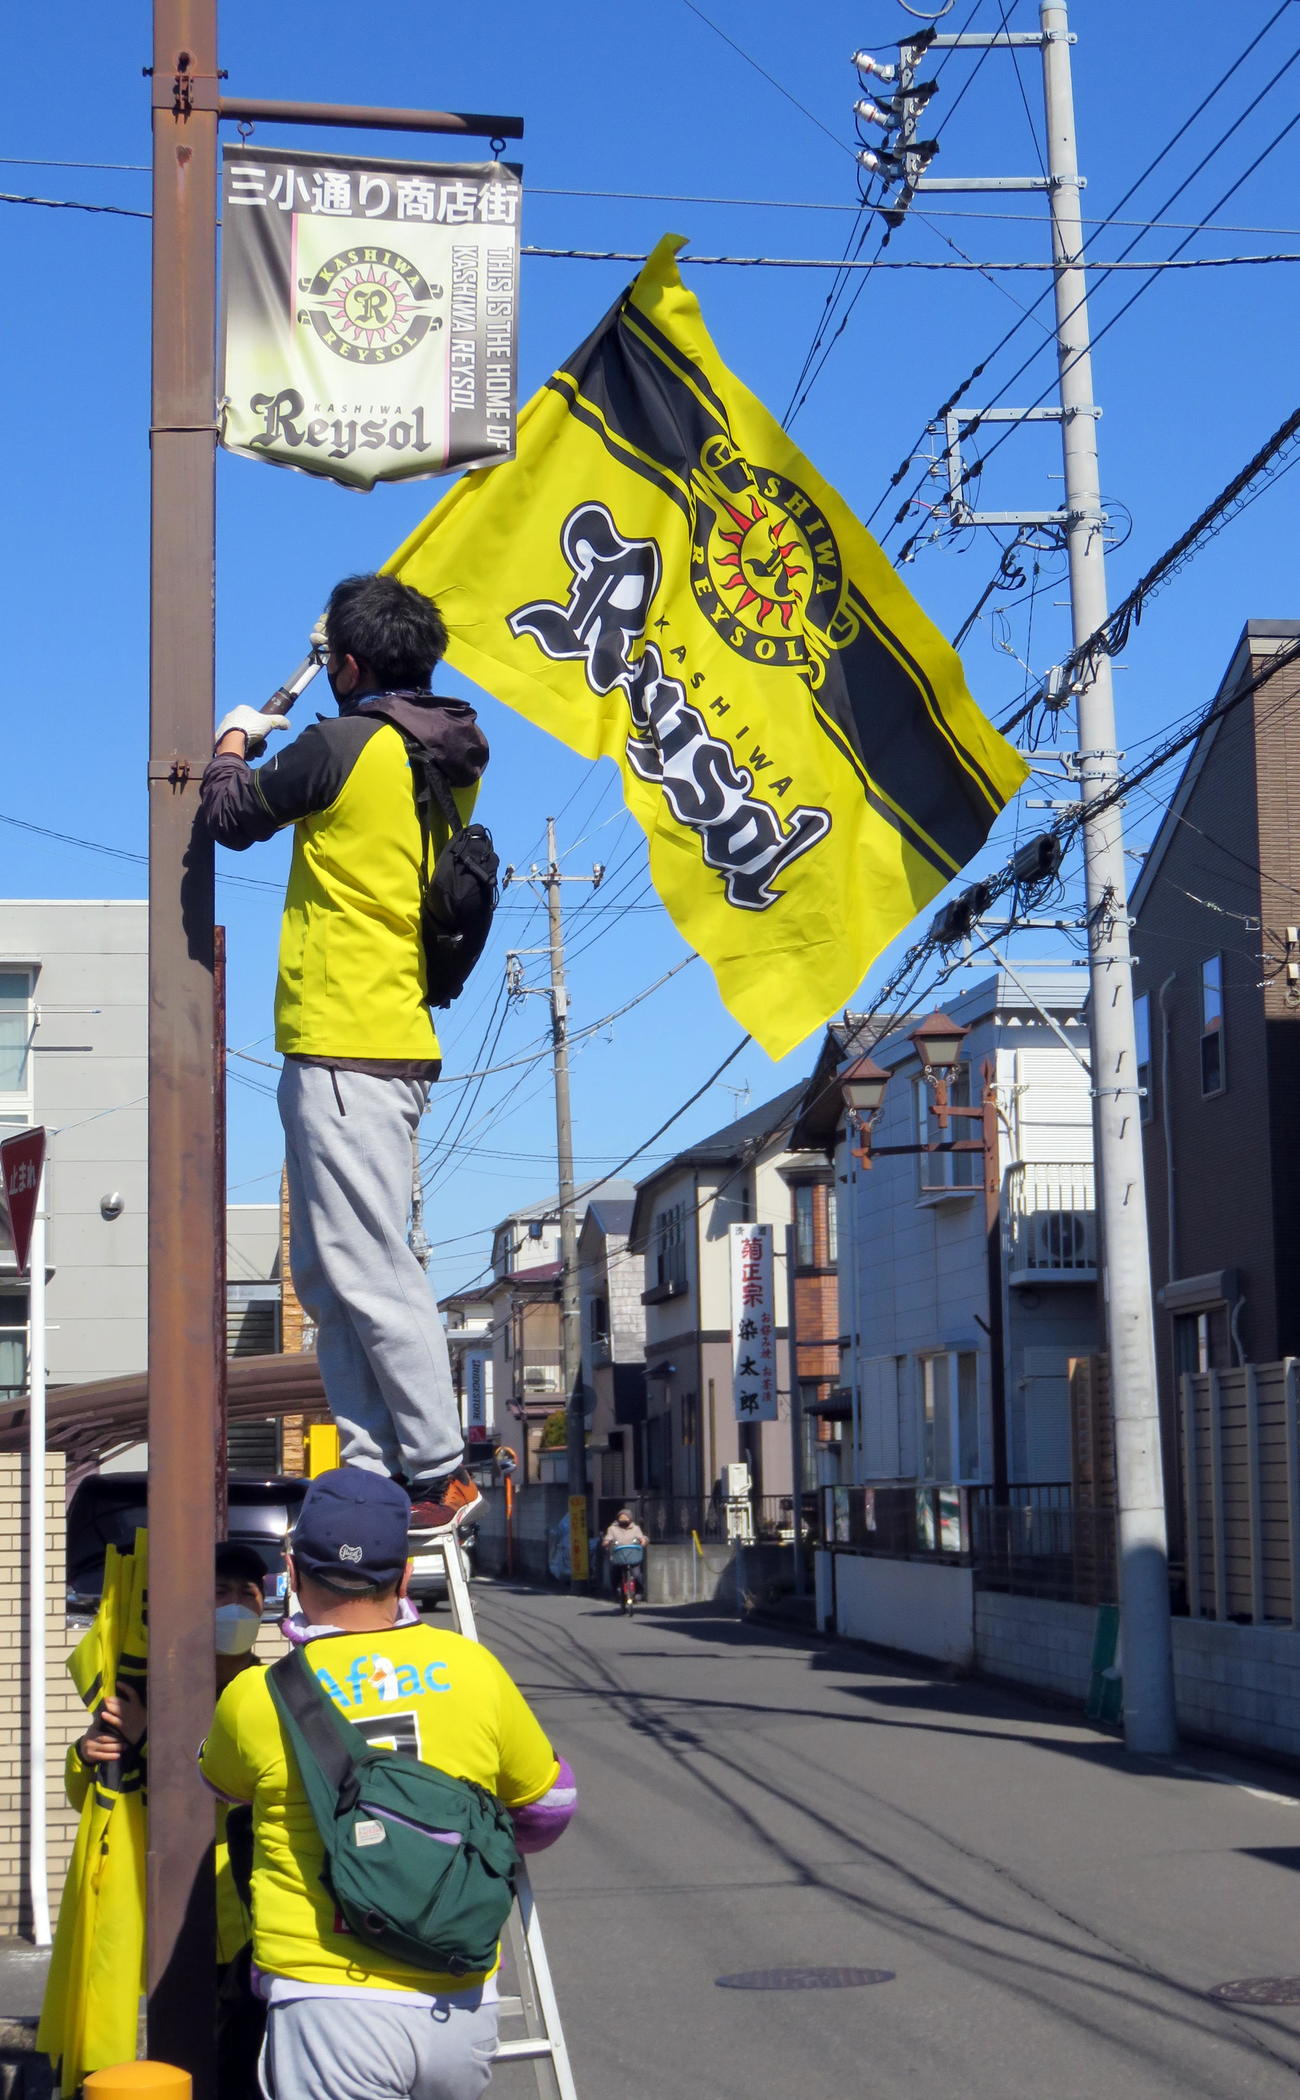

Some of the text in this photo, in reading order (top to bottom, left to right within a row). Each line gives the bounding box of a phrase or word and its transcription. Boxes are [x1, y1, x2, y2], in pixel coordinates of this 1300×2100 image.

[228, 166, 519, 224] 三小通り商店街
[319, 248, 421, 287] KASHIWA
[322, 333, 418, 362] REYSOL
[450, 245, 479, 413] KASHIWA REYSOL
[486, 247, 514, 451] THIS IS THE HOME OF
[250, 388, 432, 459] Reysol
[314, 403, 403, 415] KASHIWA
[693, 544, 804, 662] REYSOL
[654, 616, 794, 797] KASHIWA
[9, 1159, 36, 1195] 止まれ
[741, 1237, 763, 1307] 菊正宗
[738, 1319, 760, 1416] 染太郎
